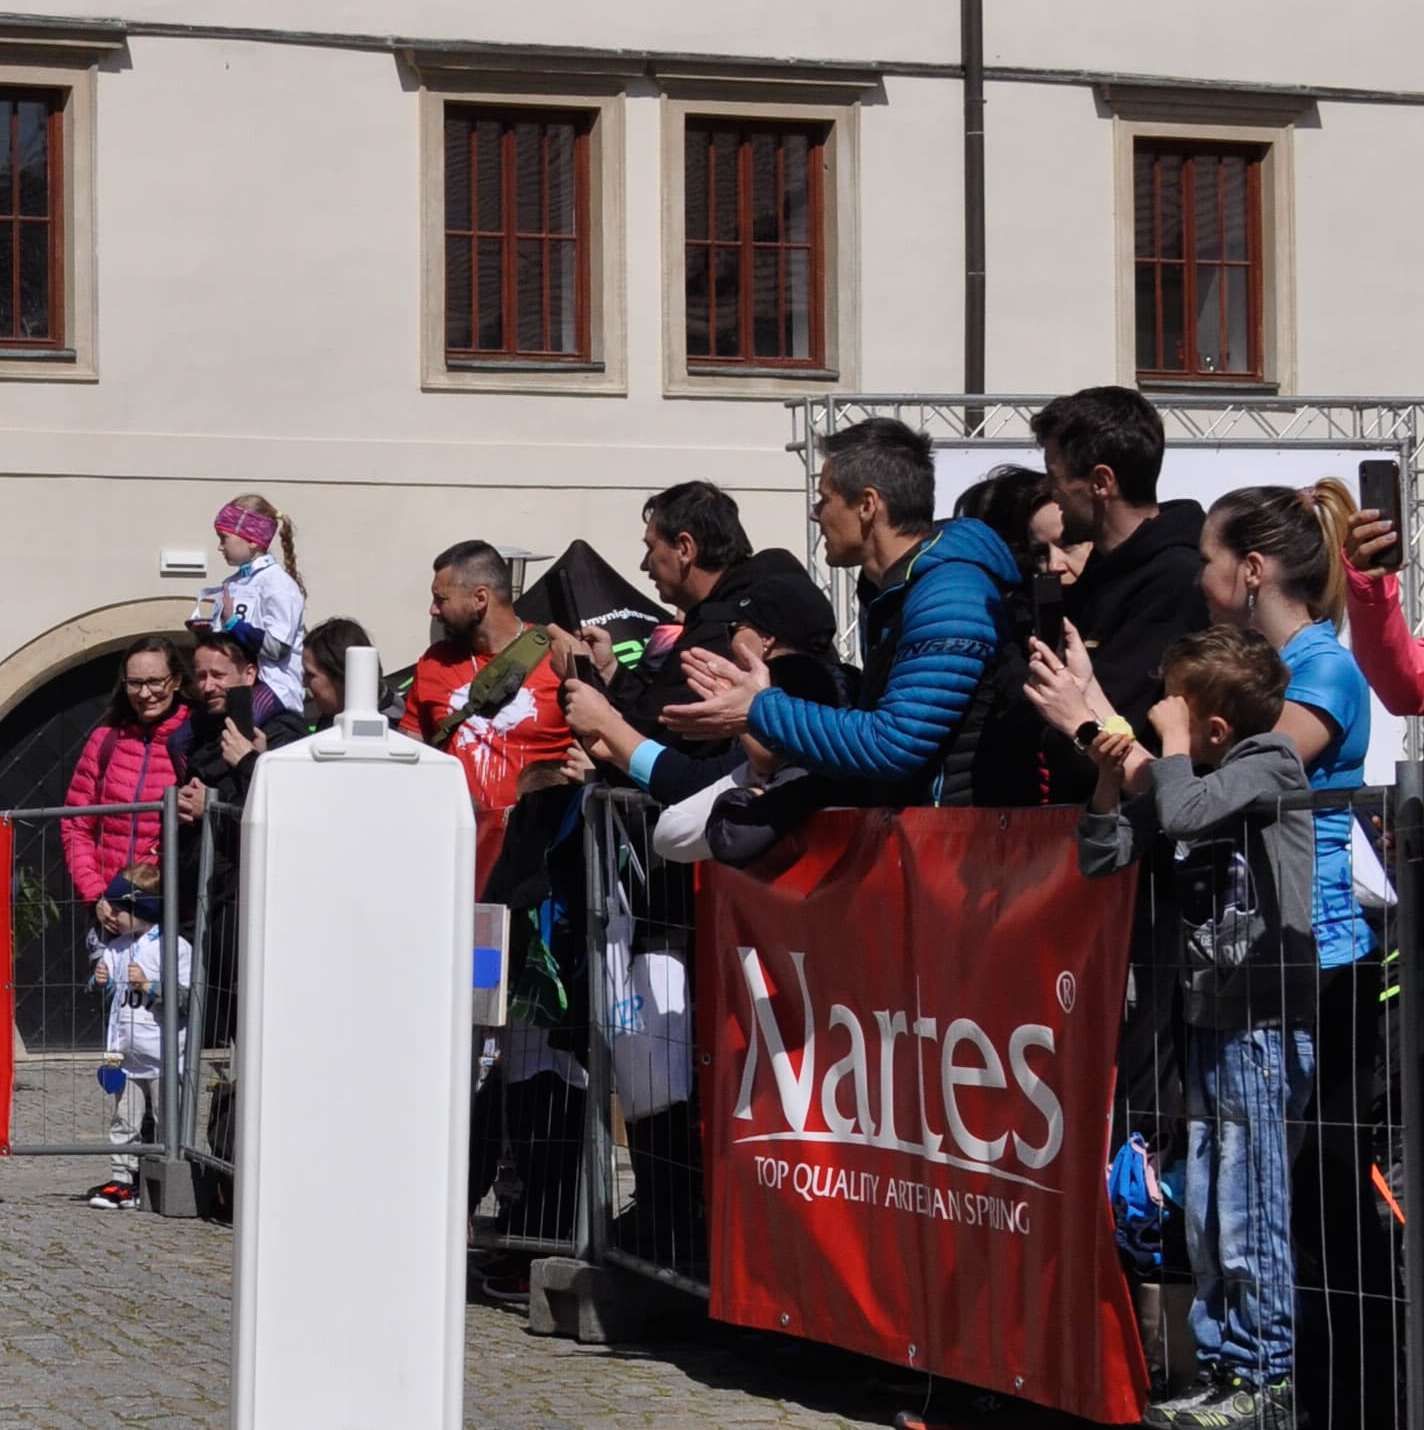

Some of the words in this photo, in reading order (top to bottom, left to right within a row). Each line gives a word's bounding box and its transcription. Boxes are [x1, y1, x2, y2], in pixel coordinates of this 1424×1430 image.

[732, 947, 1064, 1169] Nartes
[754, 1156, 789, 1189] TOP
[793, 1163, 880, 1206] QUALITY
[884, 1178, 962, 1222] ARTEIAN
[964, 1192, 1030, 1235] SPRING
